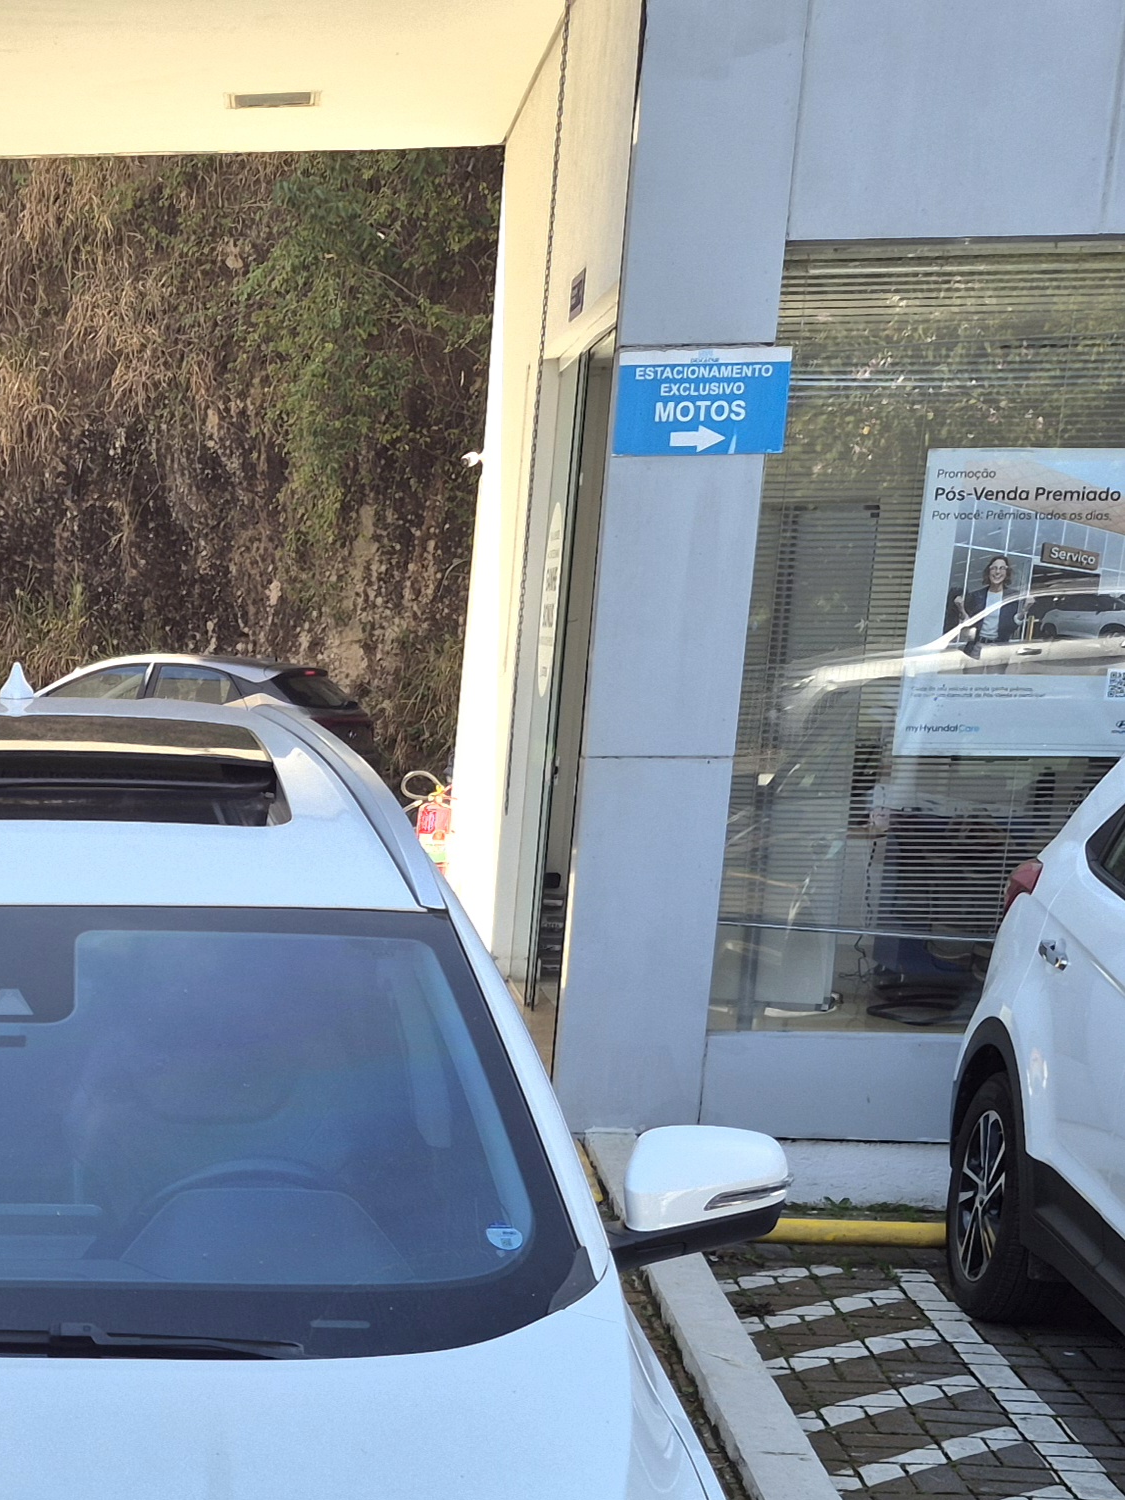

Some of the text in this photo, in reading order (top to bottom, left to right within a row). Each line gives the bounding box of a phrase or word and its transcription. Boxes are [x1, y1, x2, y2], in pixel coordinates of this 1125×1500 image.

[635, 365, 773, 380] ESTACIONAMENTO
[660, 382, 745, 396] EXCLUSIVO
[654, 400, 746, 422] MOTOS
[937, 468, 996, 480] Promoção
[934, 486, 1121, 502] Pós-Venda Premiado
[932, 511, 950, 520] Por
[986, 510, 1032, 521] Prêmios
[1035, 510, 1067, 521] todos
[1069, 512, 1083, 521] os
[1050, 547, 1096, 566] Serviço
